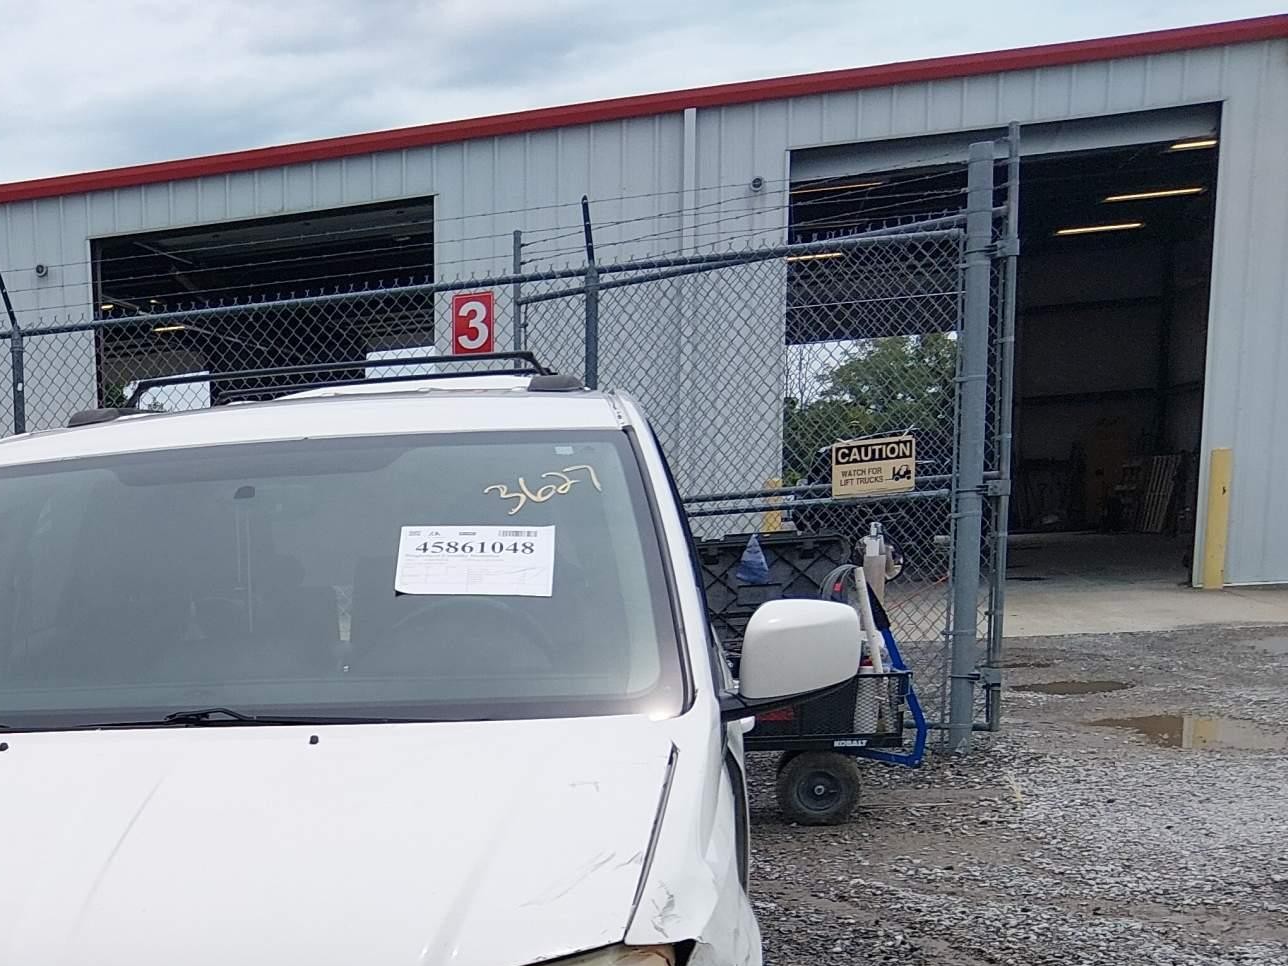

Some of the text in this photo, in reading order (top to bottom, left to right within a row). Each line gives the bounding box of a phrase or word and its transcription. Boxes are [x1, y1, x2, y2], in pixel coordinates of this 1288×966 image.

[458, 301, 489, 349] 3
[837, 442, 911, 463] CAUTION
[840, 467, 882, 478] WATCH FOR
[840, 476, 883, 486] LIFT TRUCKS
[484, 464, 602, 515] 3627
[415, 541, 535, 554] 45861048
